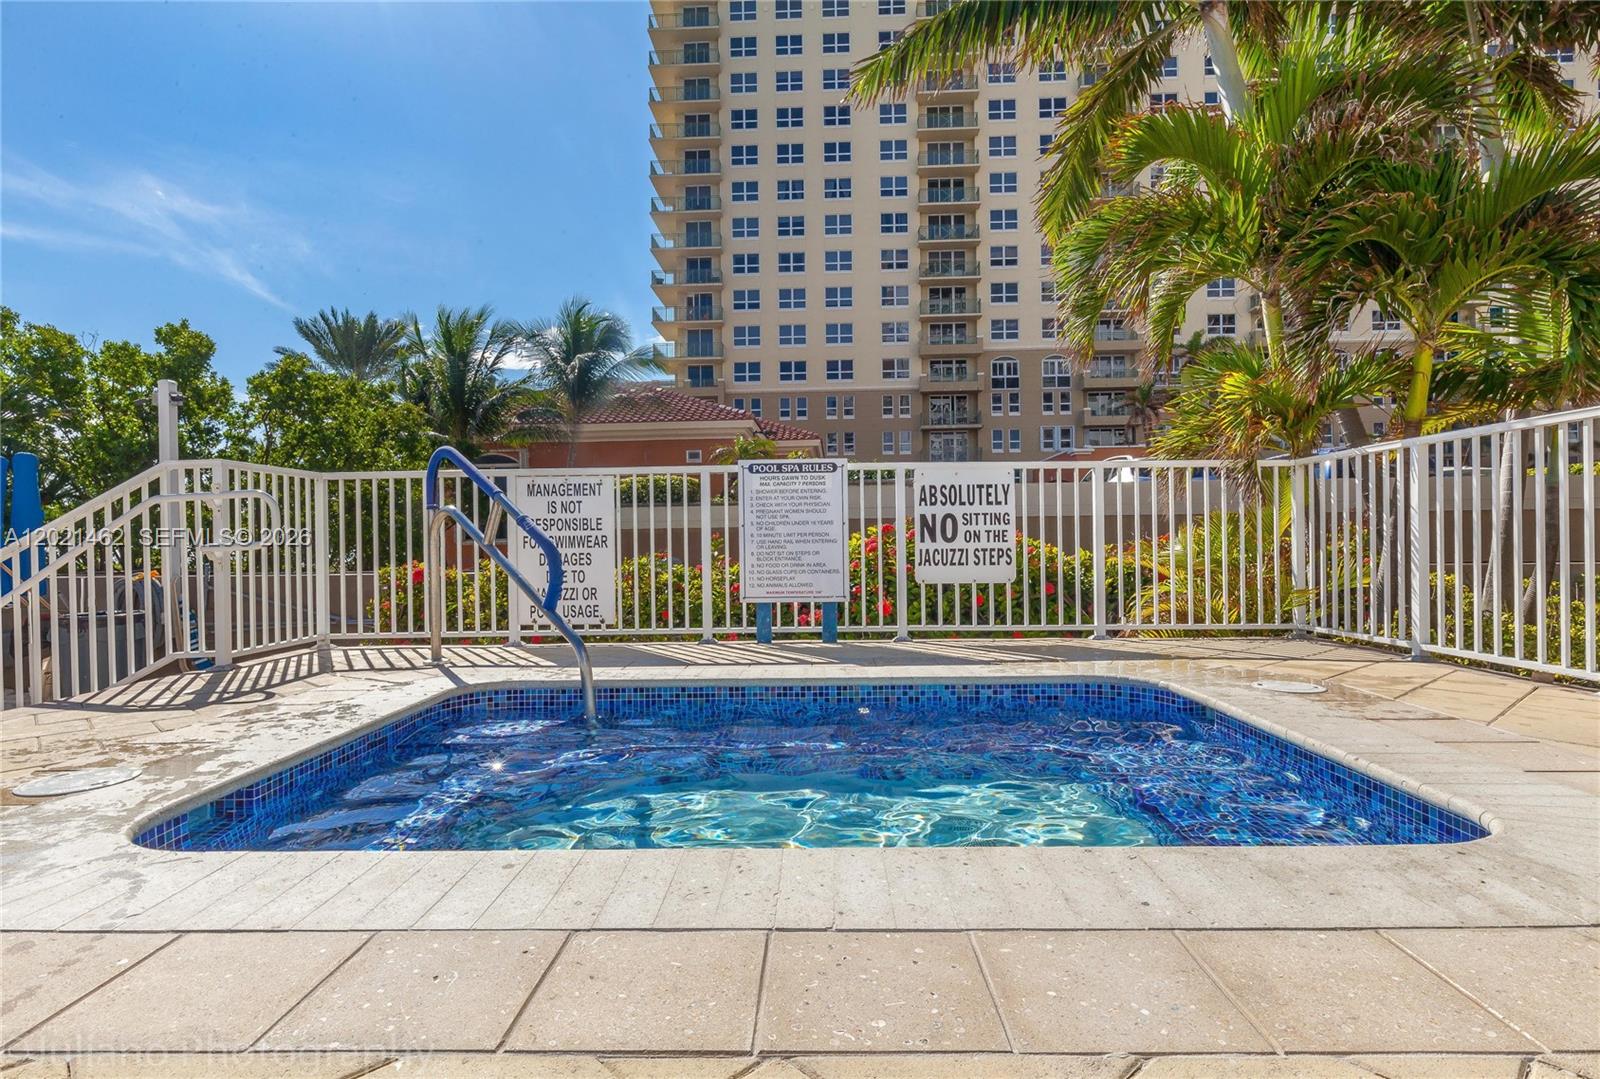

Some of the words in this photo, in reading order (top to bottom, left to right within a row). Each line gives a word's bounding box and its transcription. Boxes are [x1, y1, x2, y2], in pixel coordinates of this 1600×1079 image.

[527, 483, 602, 496] MANAGEMENT
[919, 484, 1010, 506] ABSOLUTELY
[548, 501, 557, 514] IS
[561, 500, 582, 514] NOT
[531, 518, 602, 531] ESPONSIBLE
[962, 512, 1010, 526] SITTING
[920, 513, 958, 543] NO
[549, 535, 608, 549] WIMWEAR
[964, 530, 980, 543] ON
[985, 530, 1008, 542] THE
[539, 553, 592, 566] DAGES
[918, 549, 969, 566] JACUZZI
[974, 548, 1012, 565] STEPS
[572, 570, 585, 582] TO
[582, 587, 597, 600] OR
[563, 605, 602, 618] USAGE.
